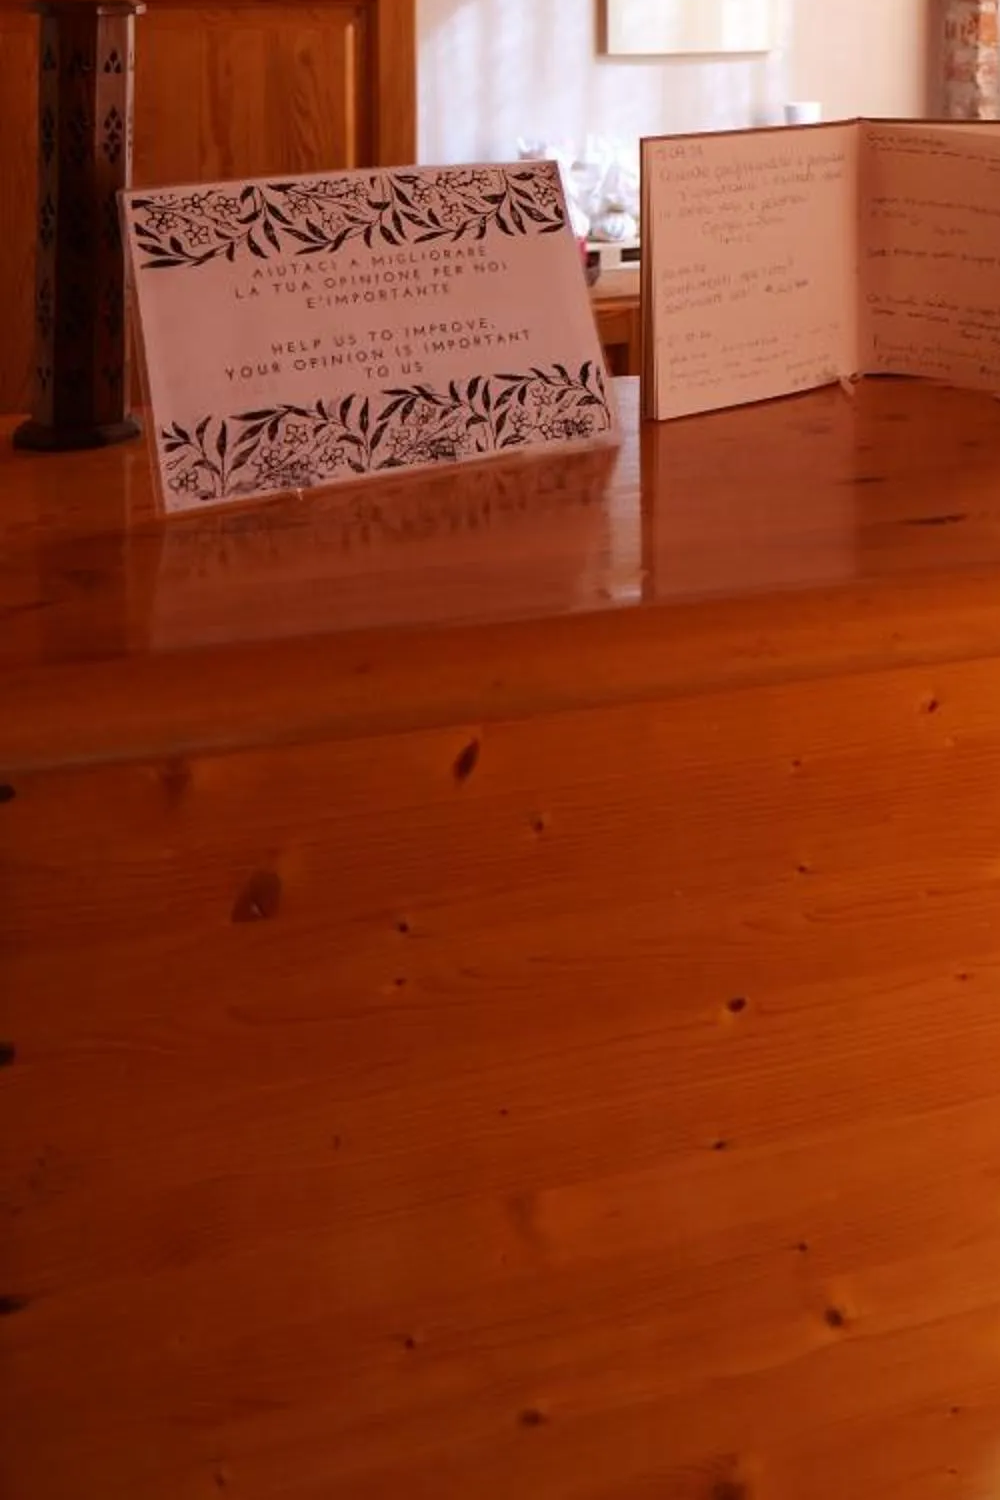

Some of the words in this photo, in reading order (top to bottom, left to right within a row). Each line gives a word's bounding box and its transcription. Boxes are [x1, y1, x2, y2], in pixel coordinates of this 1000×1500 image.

[253, 261, 336, 278] AIUTACI
[350, 258, 358, 267] A
[371, 246, 487, 267] MIGLIORARE
[235, 287, 259, 299] LA
[271, 281, 311, 294] TUA
[324, 269, 420, 289] OPINIONE
[432, 265, 463, 277] PER
[473, 261, 508, 273] NOI
[306, 283, 450, 309] E'IMPORTANTE
[225, 363, 281, 381] YOUR
[293, 350, 384, 371] OPINION
[395, 345, 412, 357] IS
[424, 329, 530, 353] IMPORTANT
[271, 338, 321, 355] HELP
[335, 335, 357, 347] US
[368, 329, 393, 342] TO
[365, 366, 390, 379] TO
[401, 361, 423, 375] US
